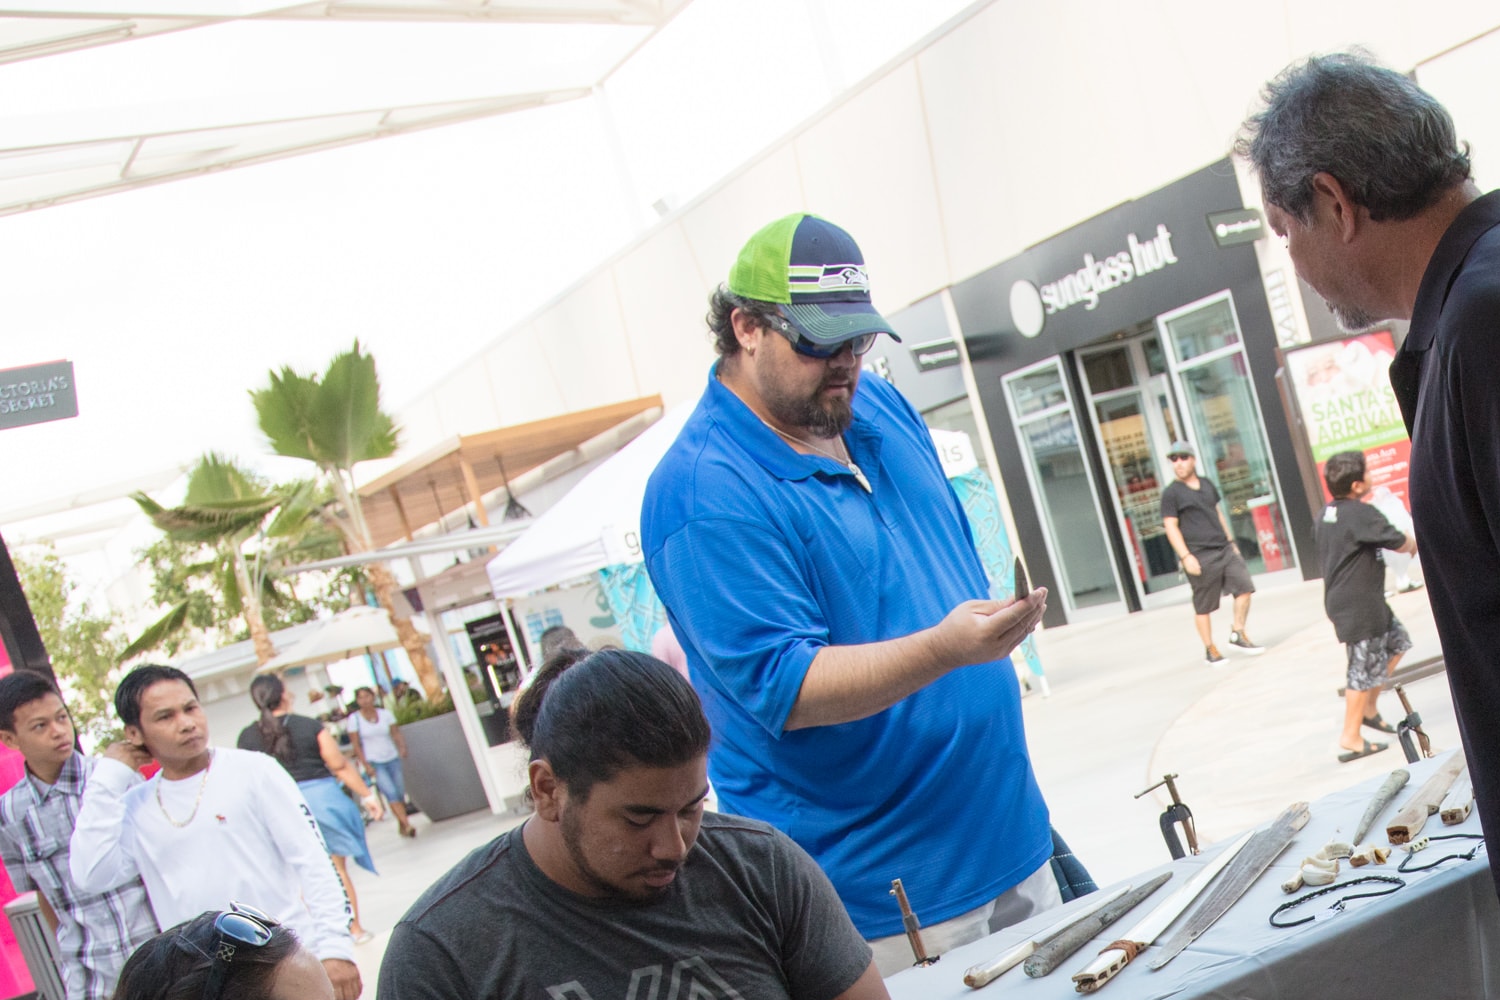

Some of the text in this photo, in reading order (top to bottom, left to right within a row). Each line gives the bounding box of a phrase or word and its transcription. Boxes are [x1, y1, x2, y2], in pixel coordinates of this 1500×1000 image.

[1040, 222, 1178, 315] sunglass hut
[0, 392, 56, 414] SECRET
[1311, 384, 1396, 422] SANTA'S
